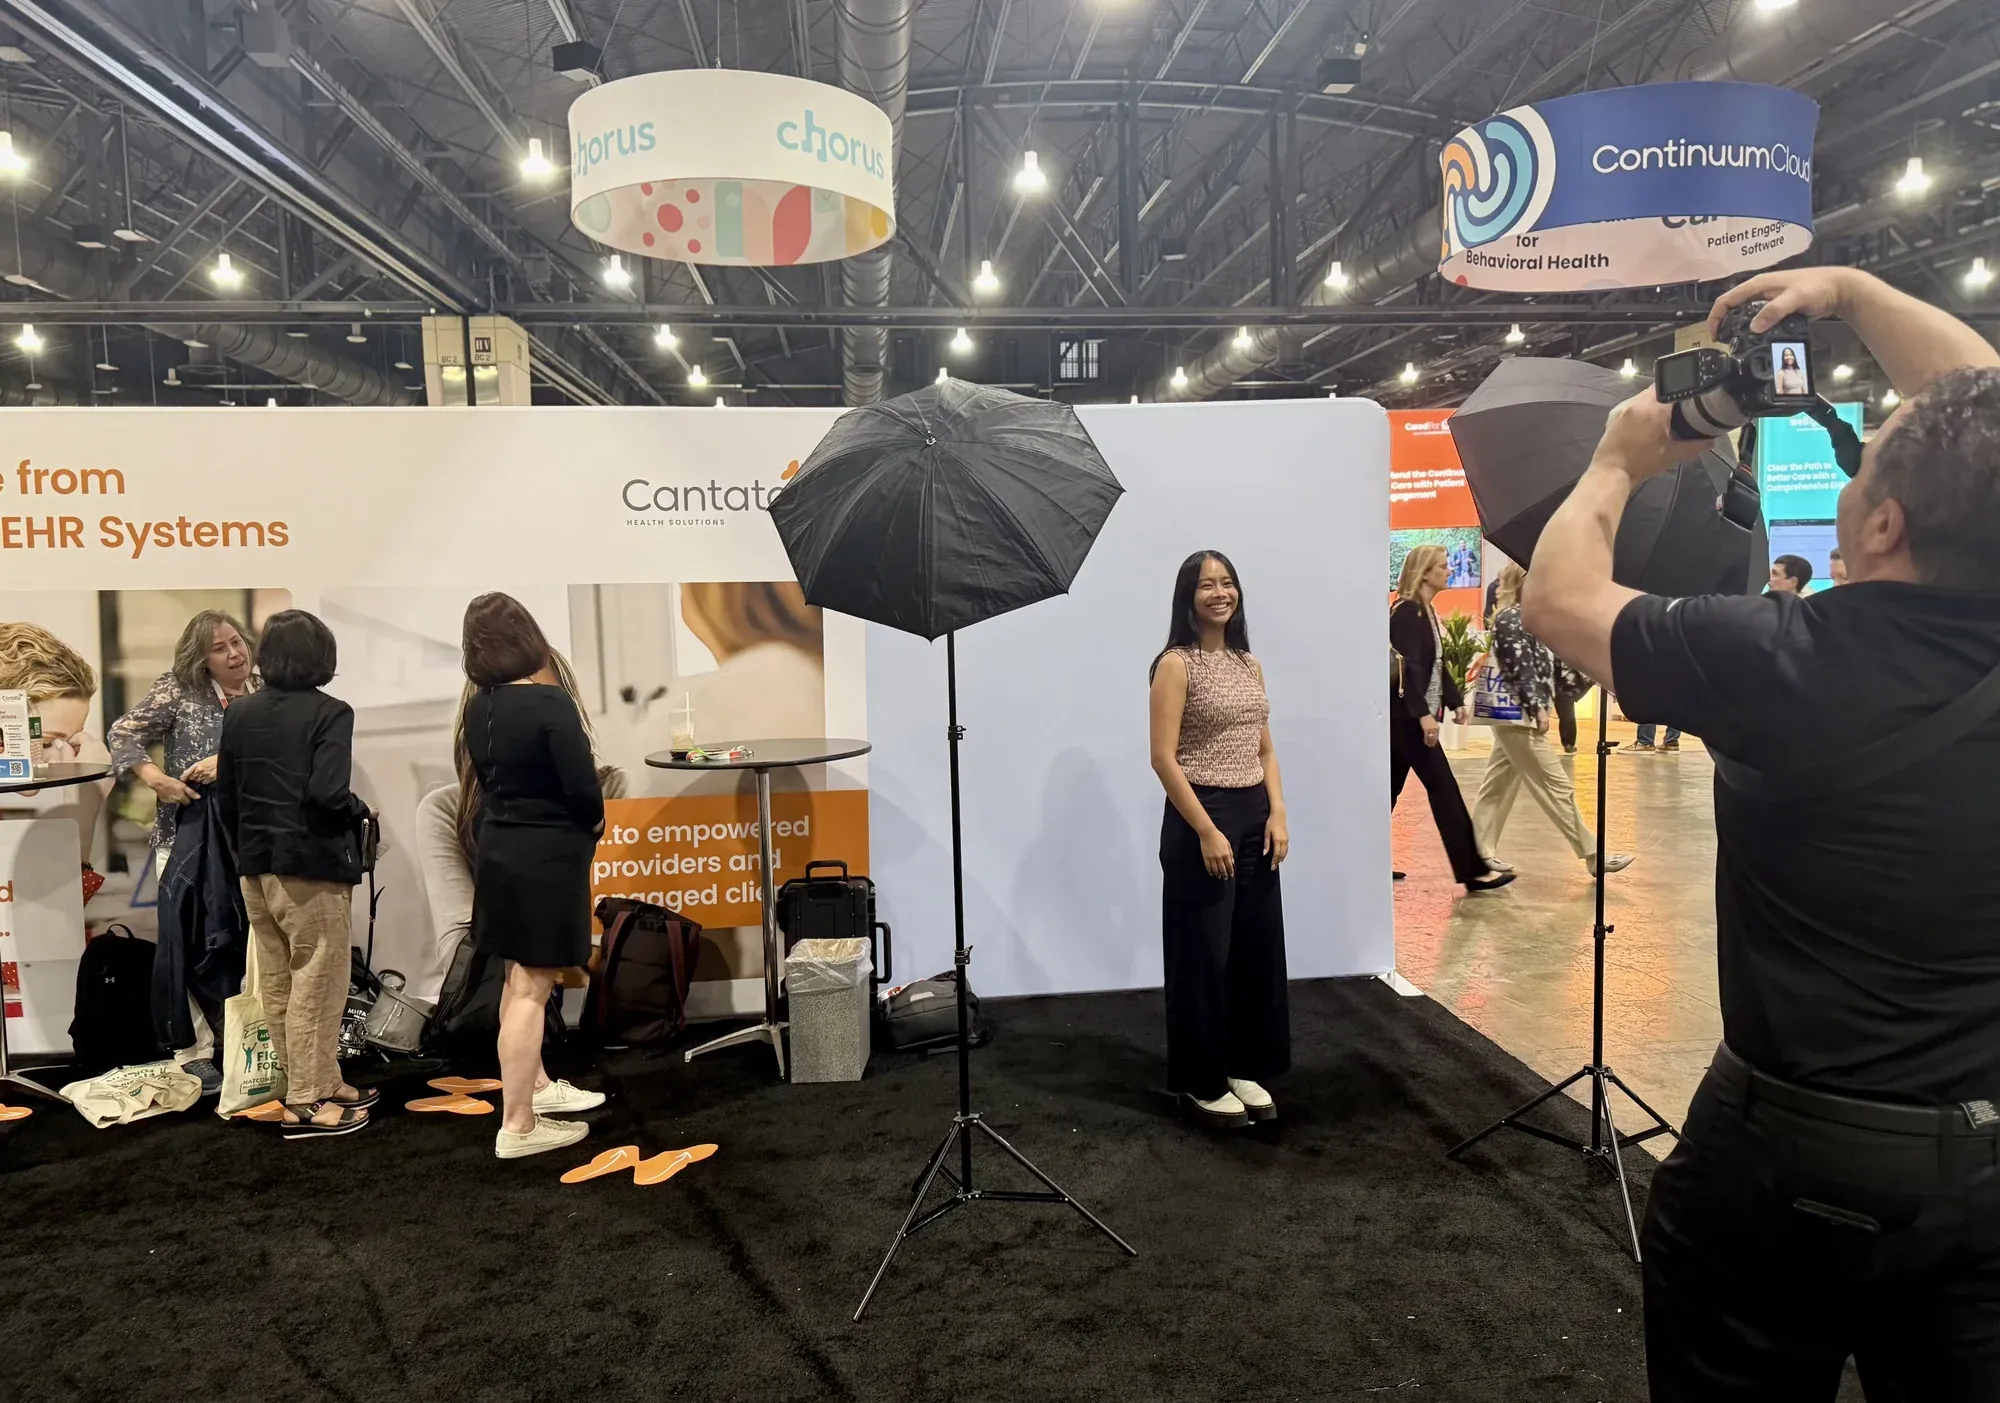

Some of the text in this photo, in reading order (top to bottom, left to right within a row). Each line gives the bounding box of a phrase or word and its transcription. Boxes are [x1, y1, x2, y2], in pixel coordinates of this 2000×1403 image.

[776, 109, 885, 180] chorus
[1592, 138, 1811, 183] ContinuumCloud
[1707, 229, 1749, 248] Patient
[1741, 235, 1785, 256] Software
[1466, 249, 1610, 270] Behavioral Health
[16, 459, 126, 495] from
[1, 515, 290, 560] EHR Systems
[646, 815, 810, 848] empoweed
[593, 848, 781, 886] providers and
